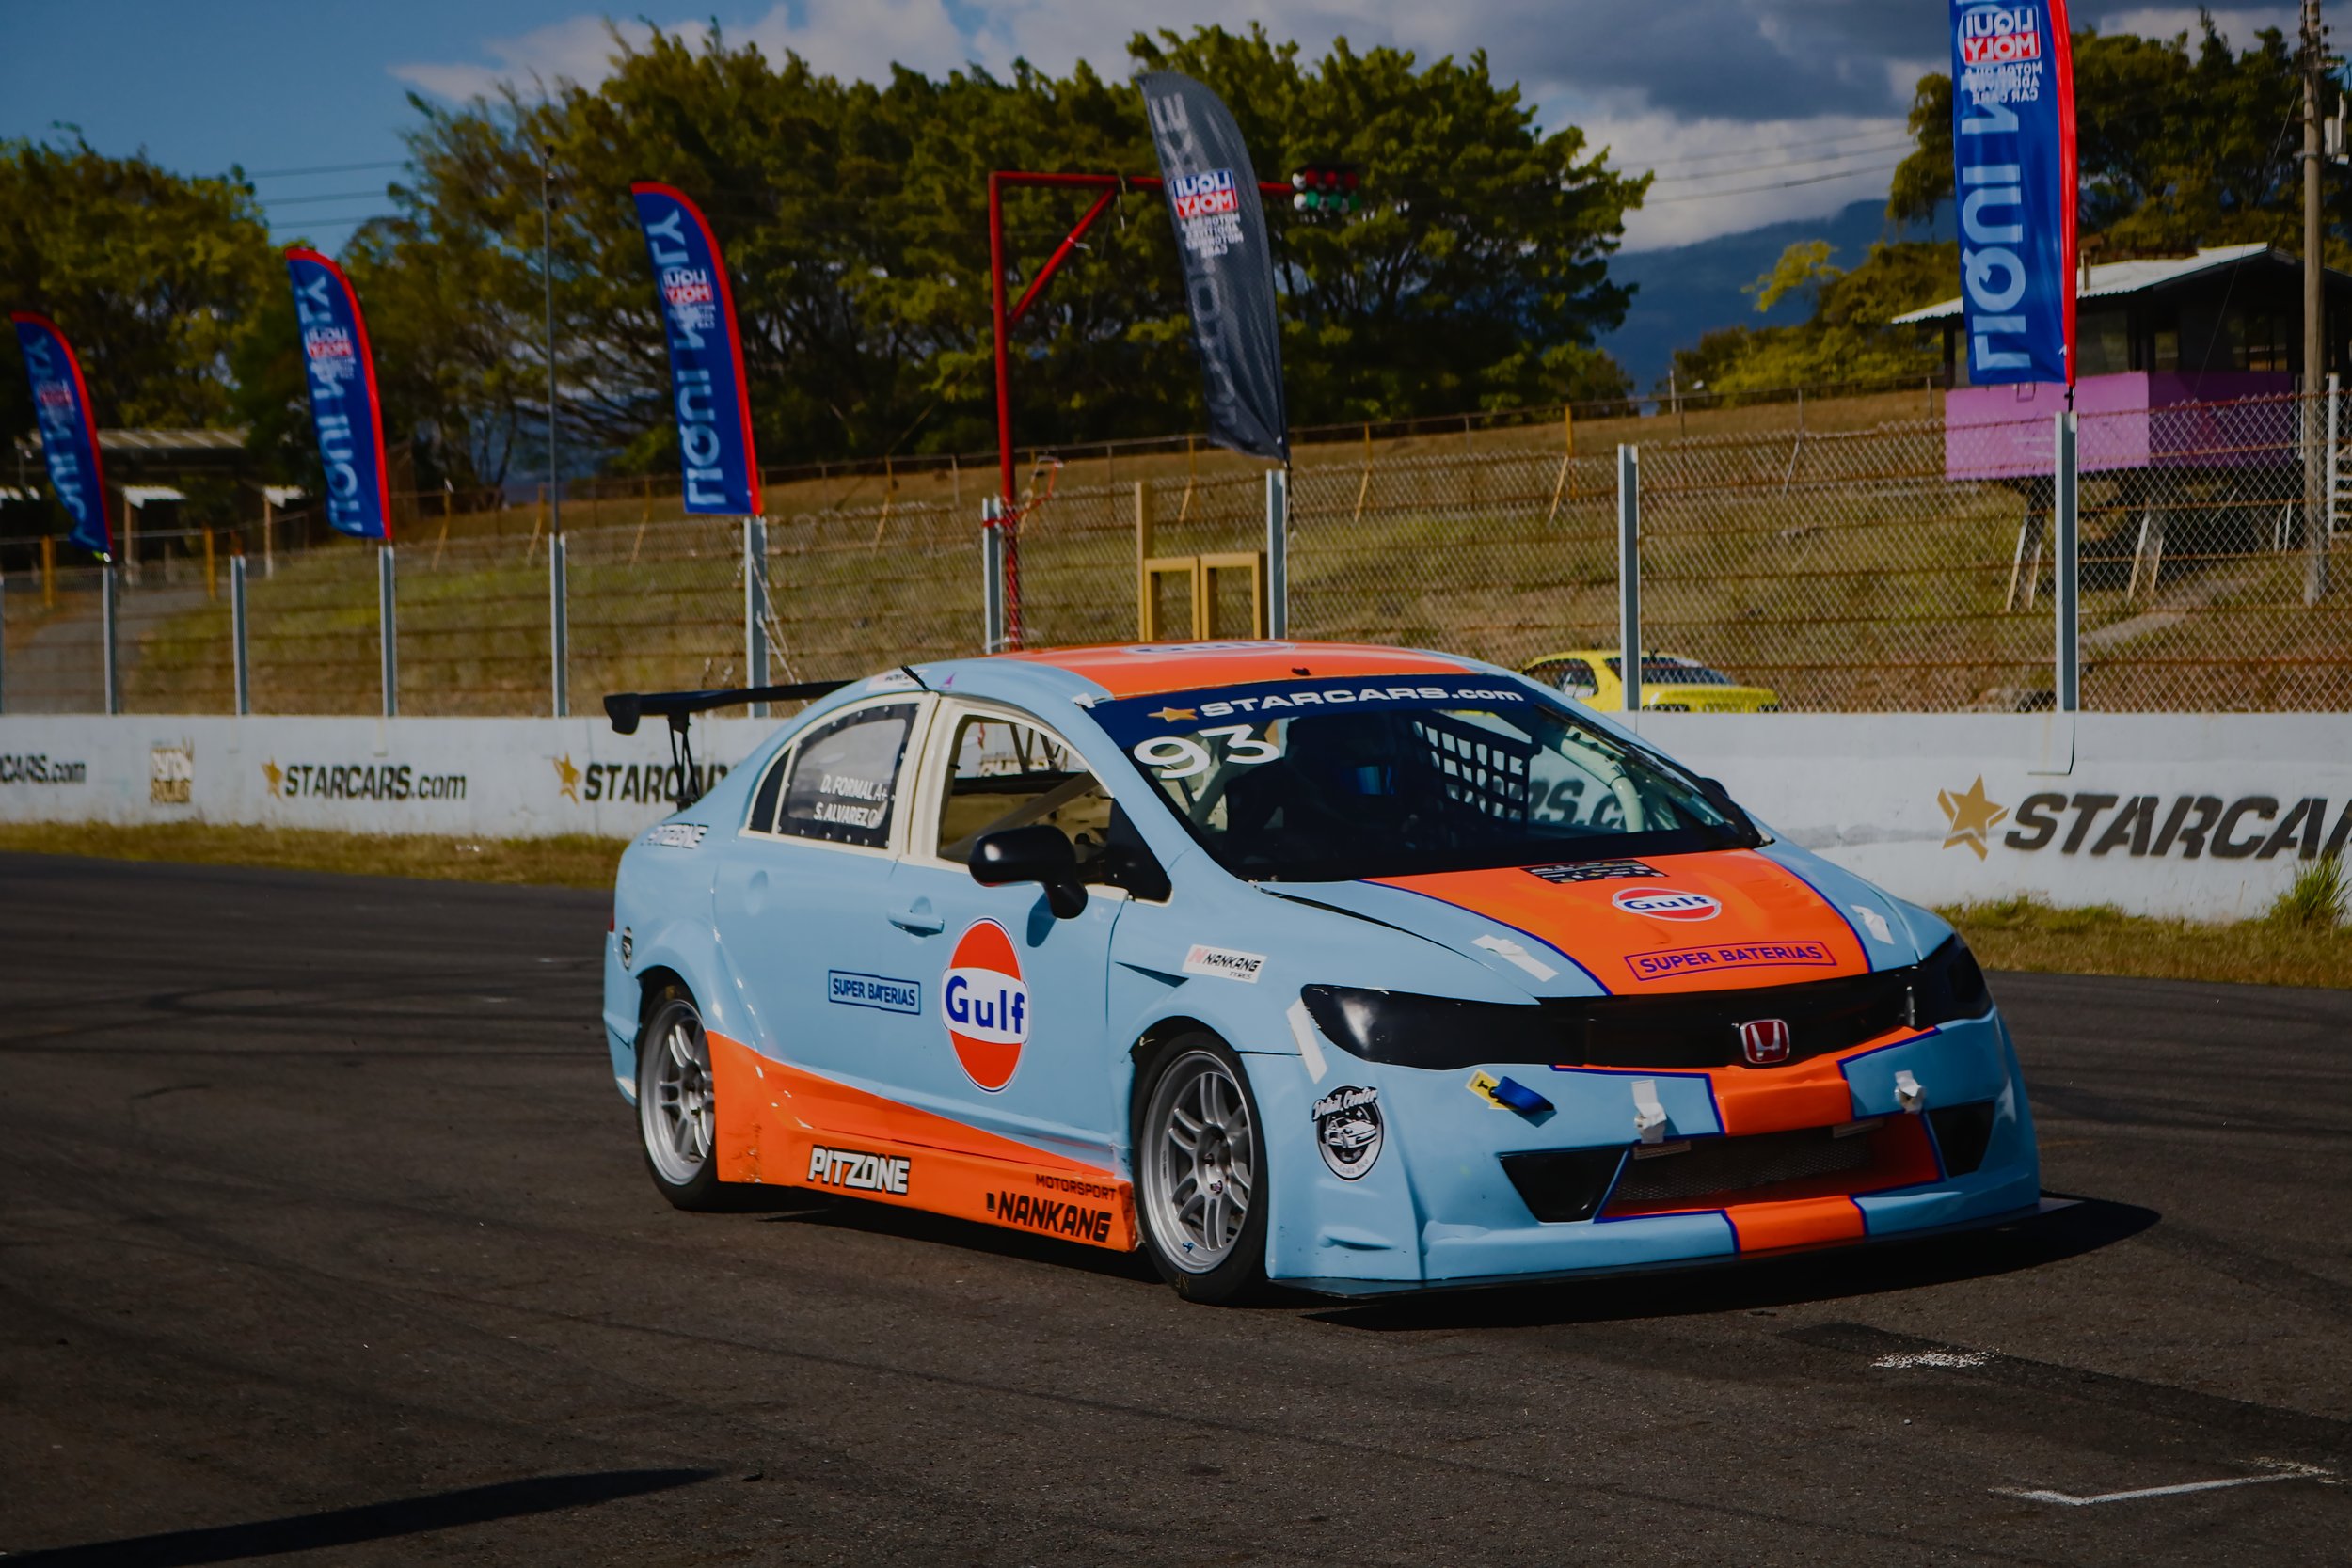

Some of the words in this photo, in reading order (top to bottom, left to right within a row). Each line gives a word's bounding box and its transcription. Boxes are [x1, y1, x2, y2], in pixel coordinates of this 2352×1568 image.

[1200, 686, 1524, 718] STARCARS.com
[1134, 724, 1280, 779] 93
[285, 764, 468, 800] STARCARS.com
[1624, 894, 1709, 911] Gulf
[1202, 953, 1262, 972] NANKANG
[1639, 953, 1712, 974] SUPER
[1722, 945, 1824, 963] BATERIAS
[833, 979, 866, 1000] SUPER
[868, 982, 915, 1006] BATERIAS
[945, 975, 1025, 1034] Gulf
[807, 1145, 911, 1195] PITZONE
[1035, 1174, 1117, 1201] MOTORSPORT
[997, 1191, 1113, 1243] NANKANG
